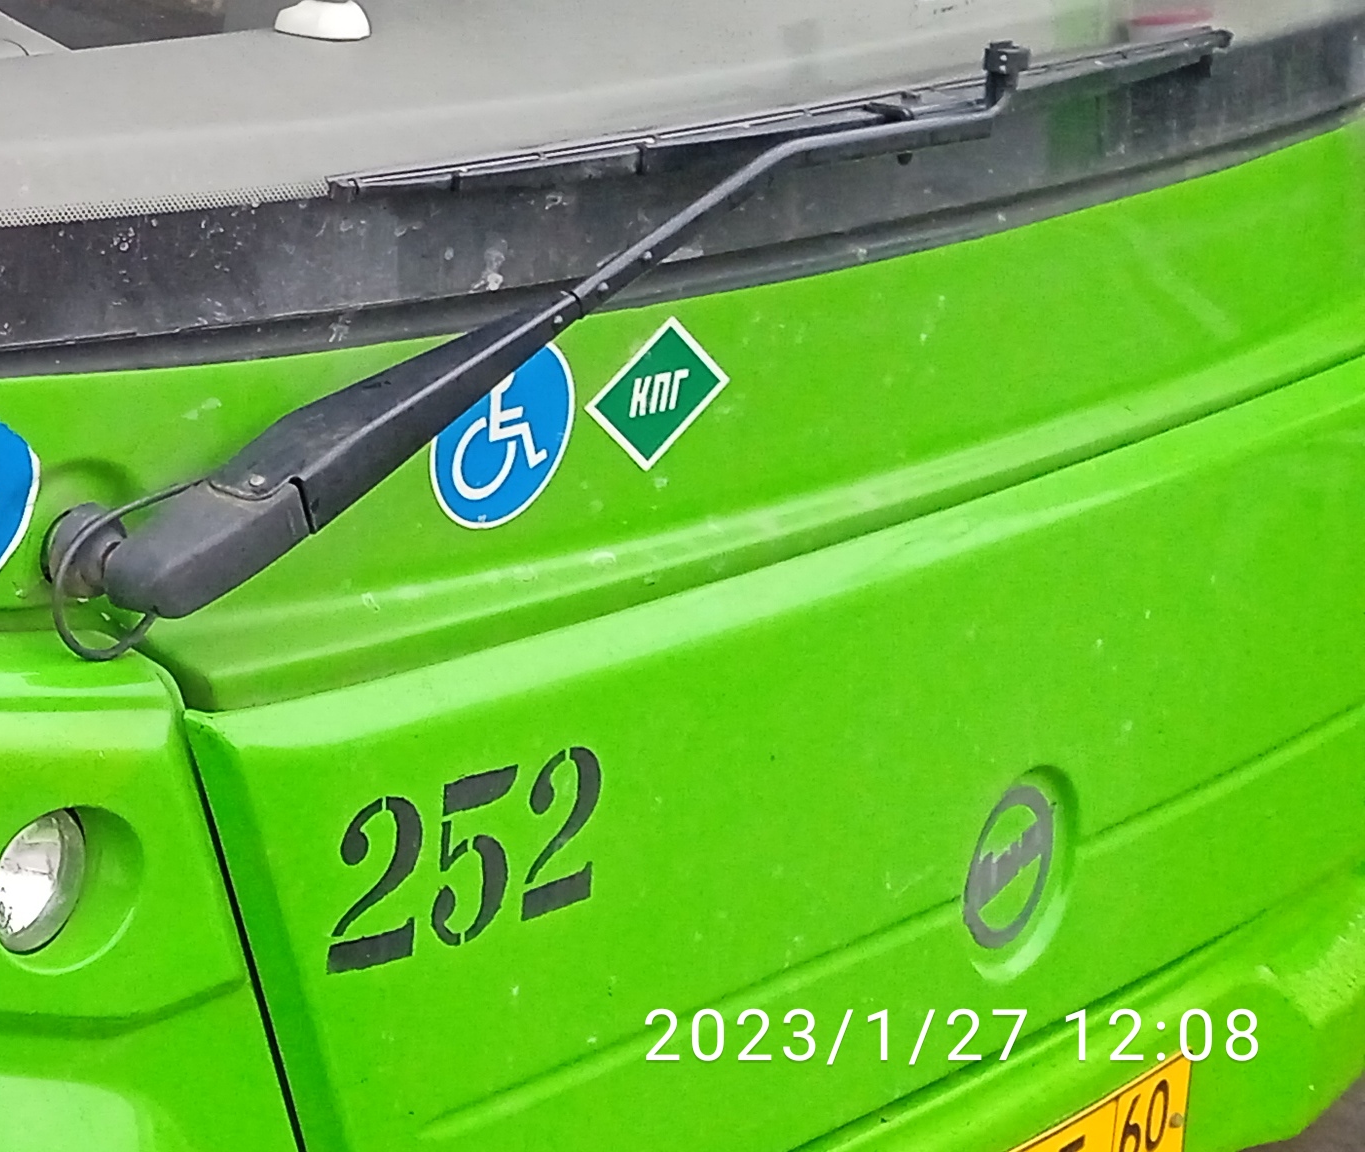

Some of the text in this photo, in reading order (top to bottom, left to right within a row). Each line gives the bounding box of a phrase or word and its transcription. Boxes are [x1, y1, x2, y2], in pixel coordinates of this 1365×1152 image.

[628, 368, 690, 419] КПГ
[326, 746, 603, 975] 252
[1115, 1078, 1171, 1152] 60
